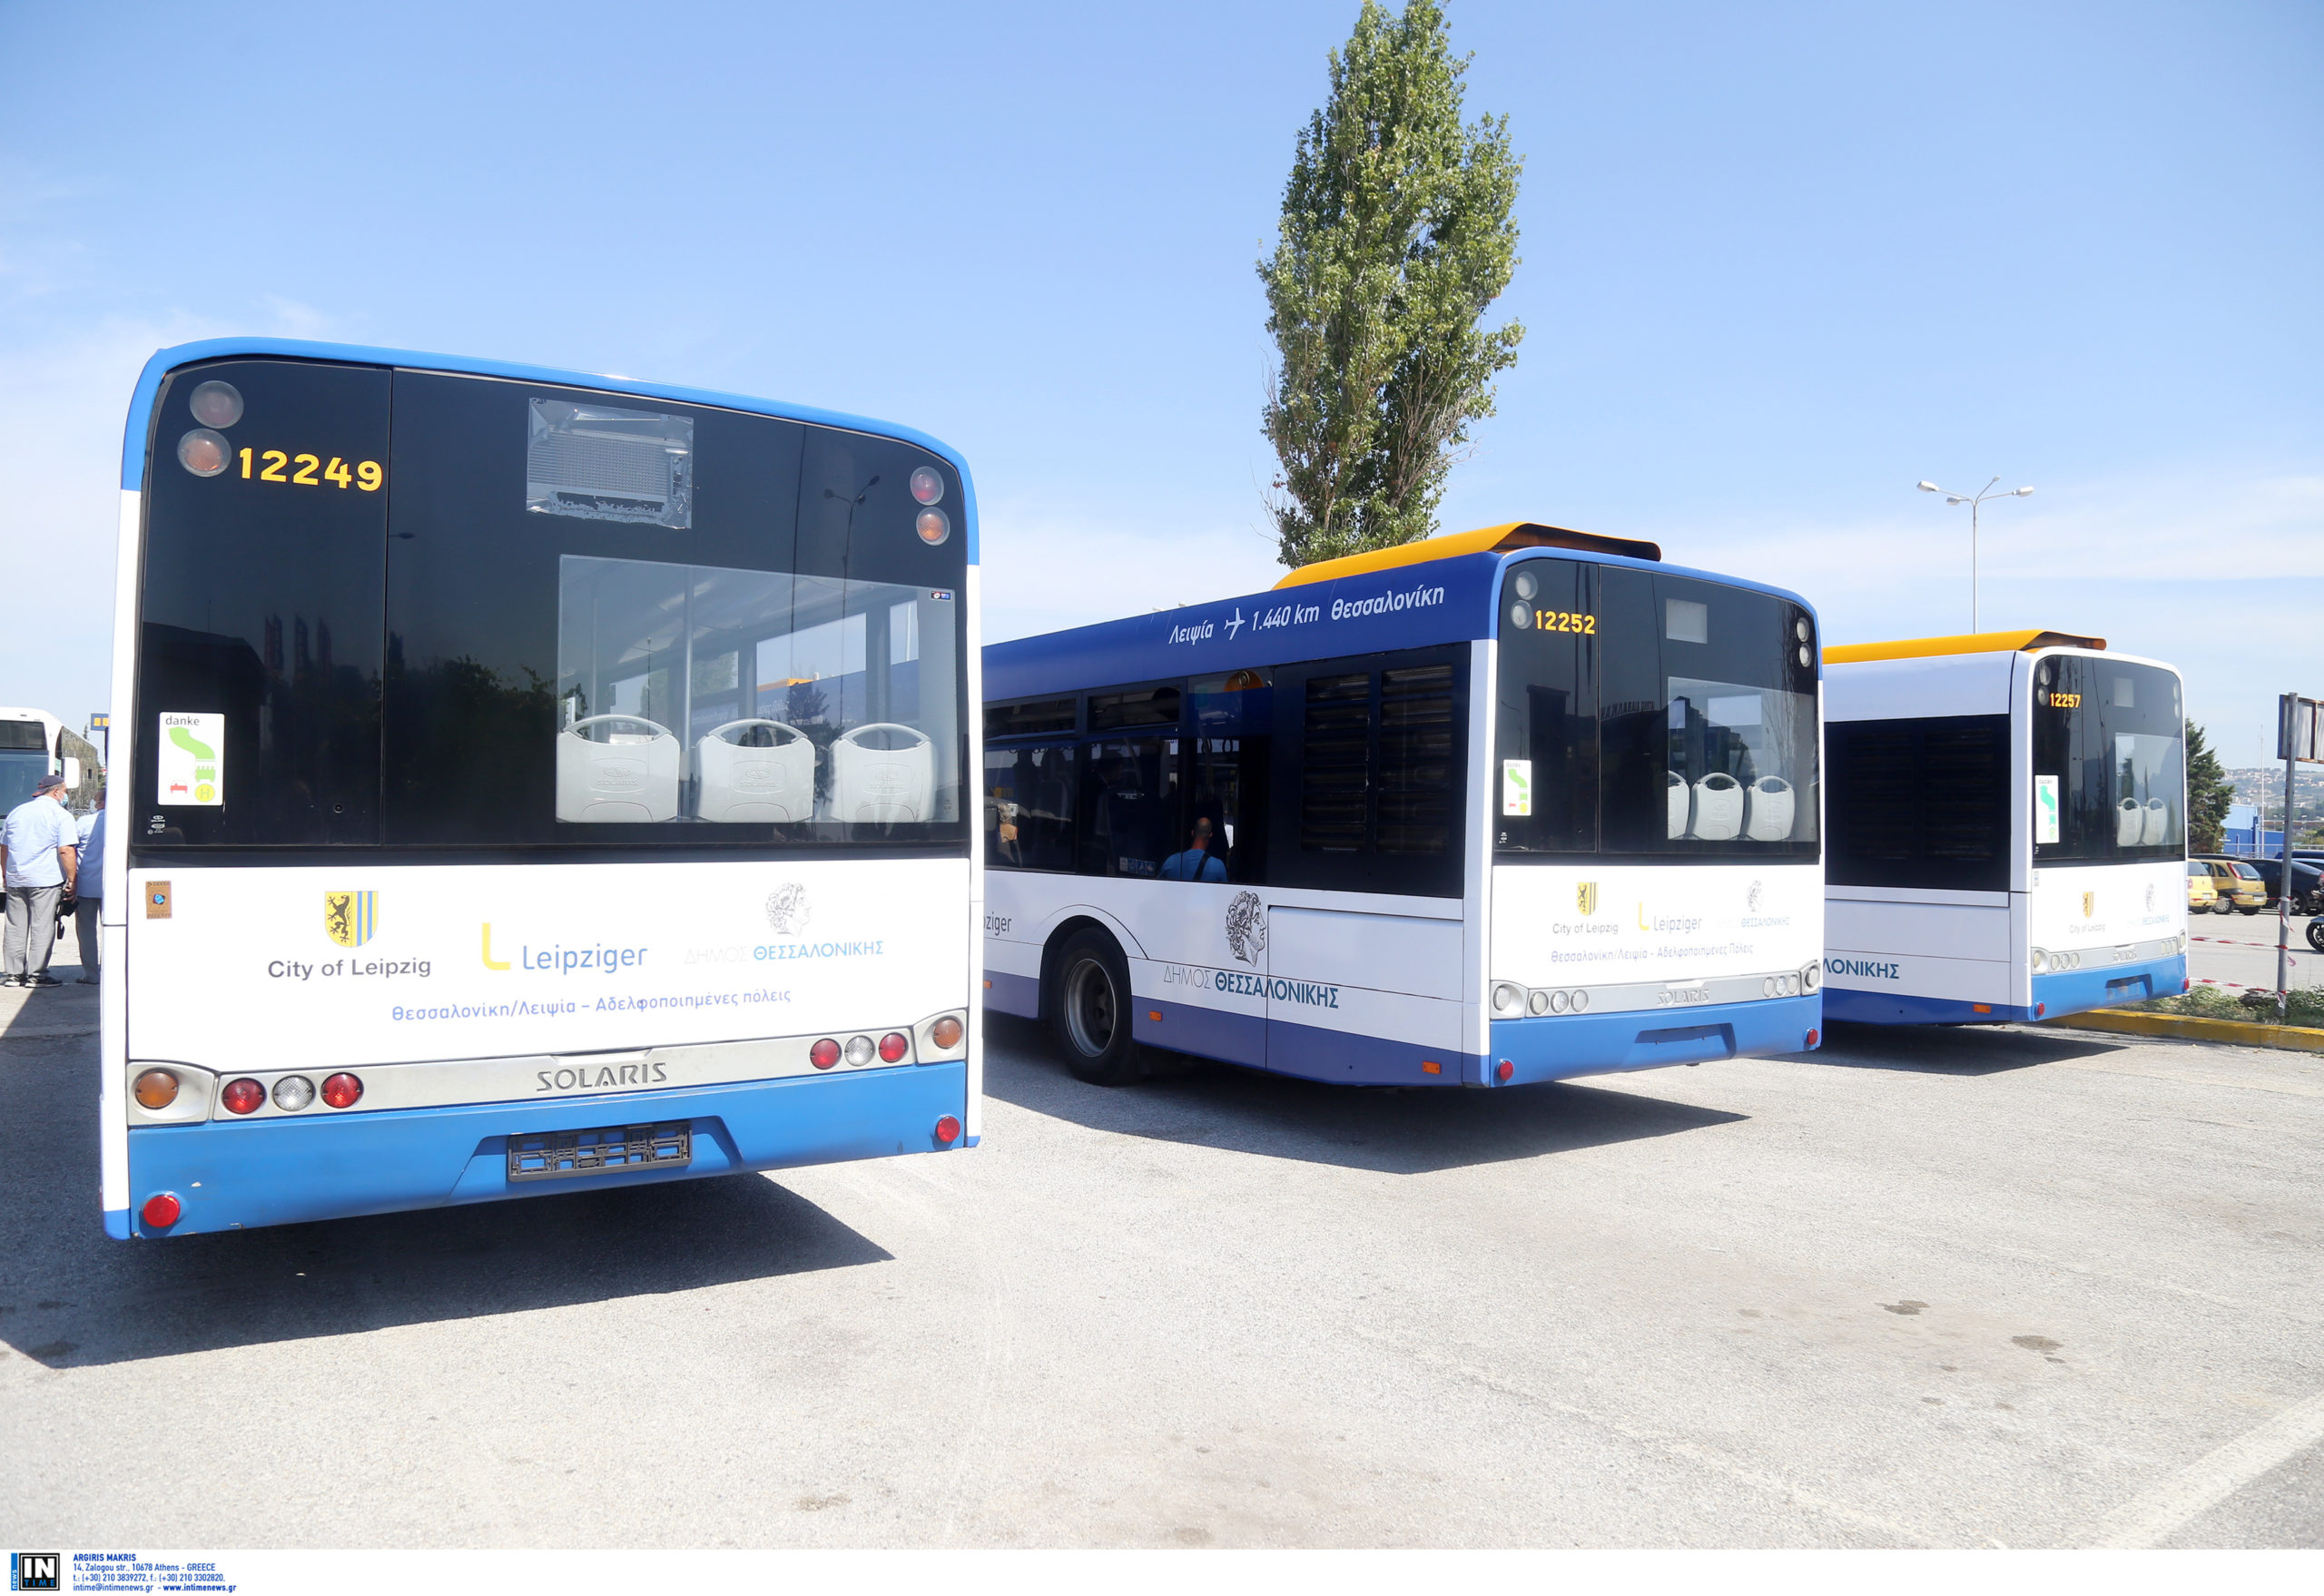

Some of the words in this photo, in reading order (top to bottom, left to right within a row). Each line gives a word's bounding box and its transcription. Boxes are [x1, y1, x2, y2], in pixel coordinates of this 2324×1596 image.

[239, 447, 384, 492] 12249
[1331, 584, 1444, 621] Θεσσαλονίκη
[1252, 606, 1292, 631] 1.440
[1294, 604, 1320, 625] km
[1535, 609, 1596, 635] 12252
[1168, 619, 1215, 645] Λειψία
[2050, 693, 2082, 708] 12257
[165, 715, 200, 726] danke
[1552, 922, 1571, 935] City
[1574, 921, 1584, 933] of
[1586, 921, 1619, 934] Leipzig
[1653, 915, 1702, 934] Leipziger
[522, 942, 648, 975] Leipziger
[684, 946, 749, 965] ΔΗΜΟΣ
[753, 941, 884, 961] ΘΕΣΣΑΛΟΝΙΚΗΣ
[268, 960, 314, 981] City
[321, 959, 344, 977] of
[351, 957, 431, 979] Leipzig
[1163, 965, 1211, 990] ΔΗΜΟΣ
[1215, 971, 1339, 1009] ΘΕΣΣΑΛΟΝΙΚΗΣ
[1657, 988, 1710, 1006] SOLARIS
[392, 998, 576, 1021] Θεσσαλονίκη/Λειψία
[596, 991, 739, 1014] Αδελφοποιημένες
[743, 989, 792, 1004] πόλεις
[536, 1062, 667, 1092] SOLARIS
